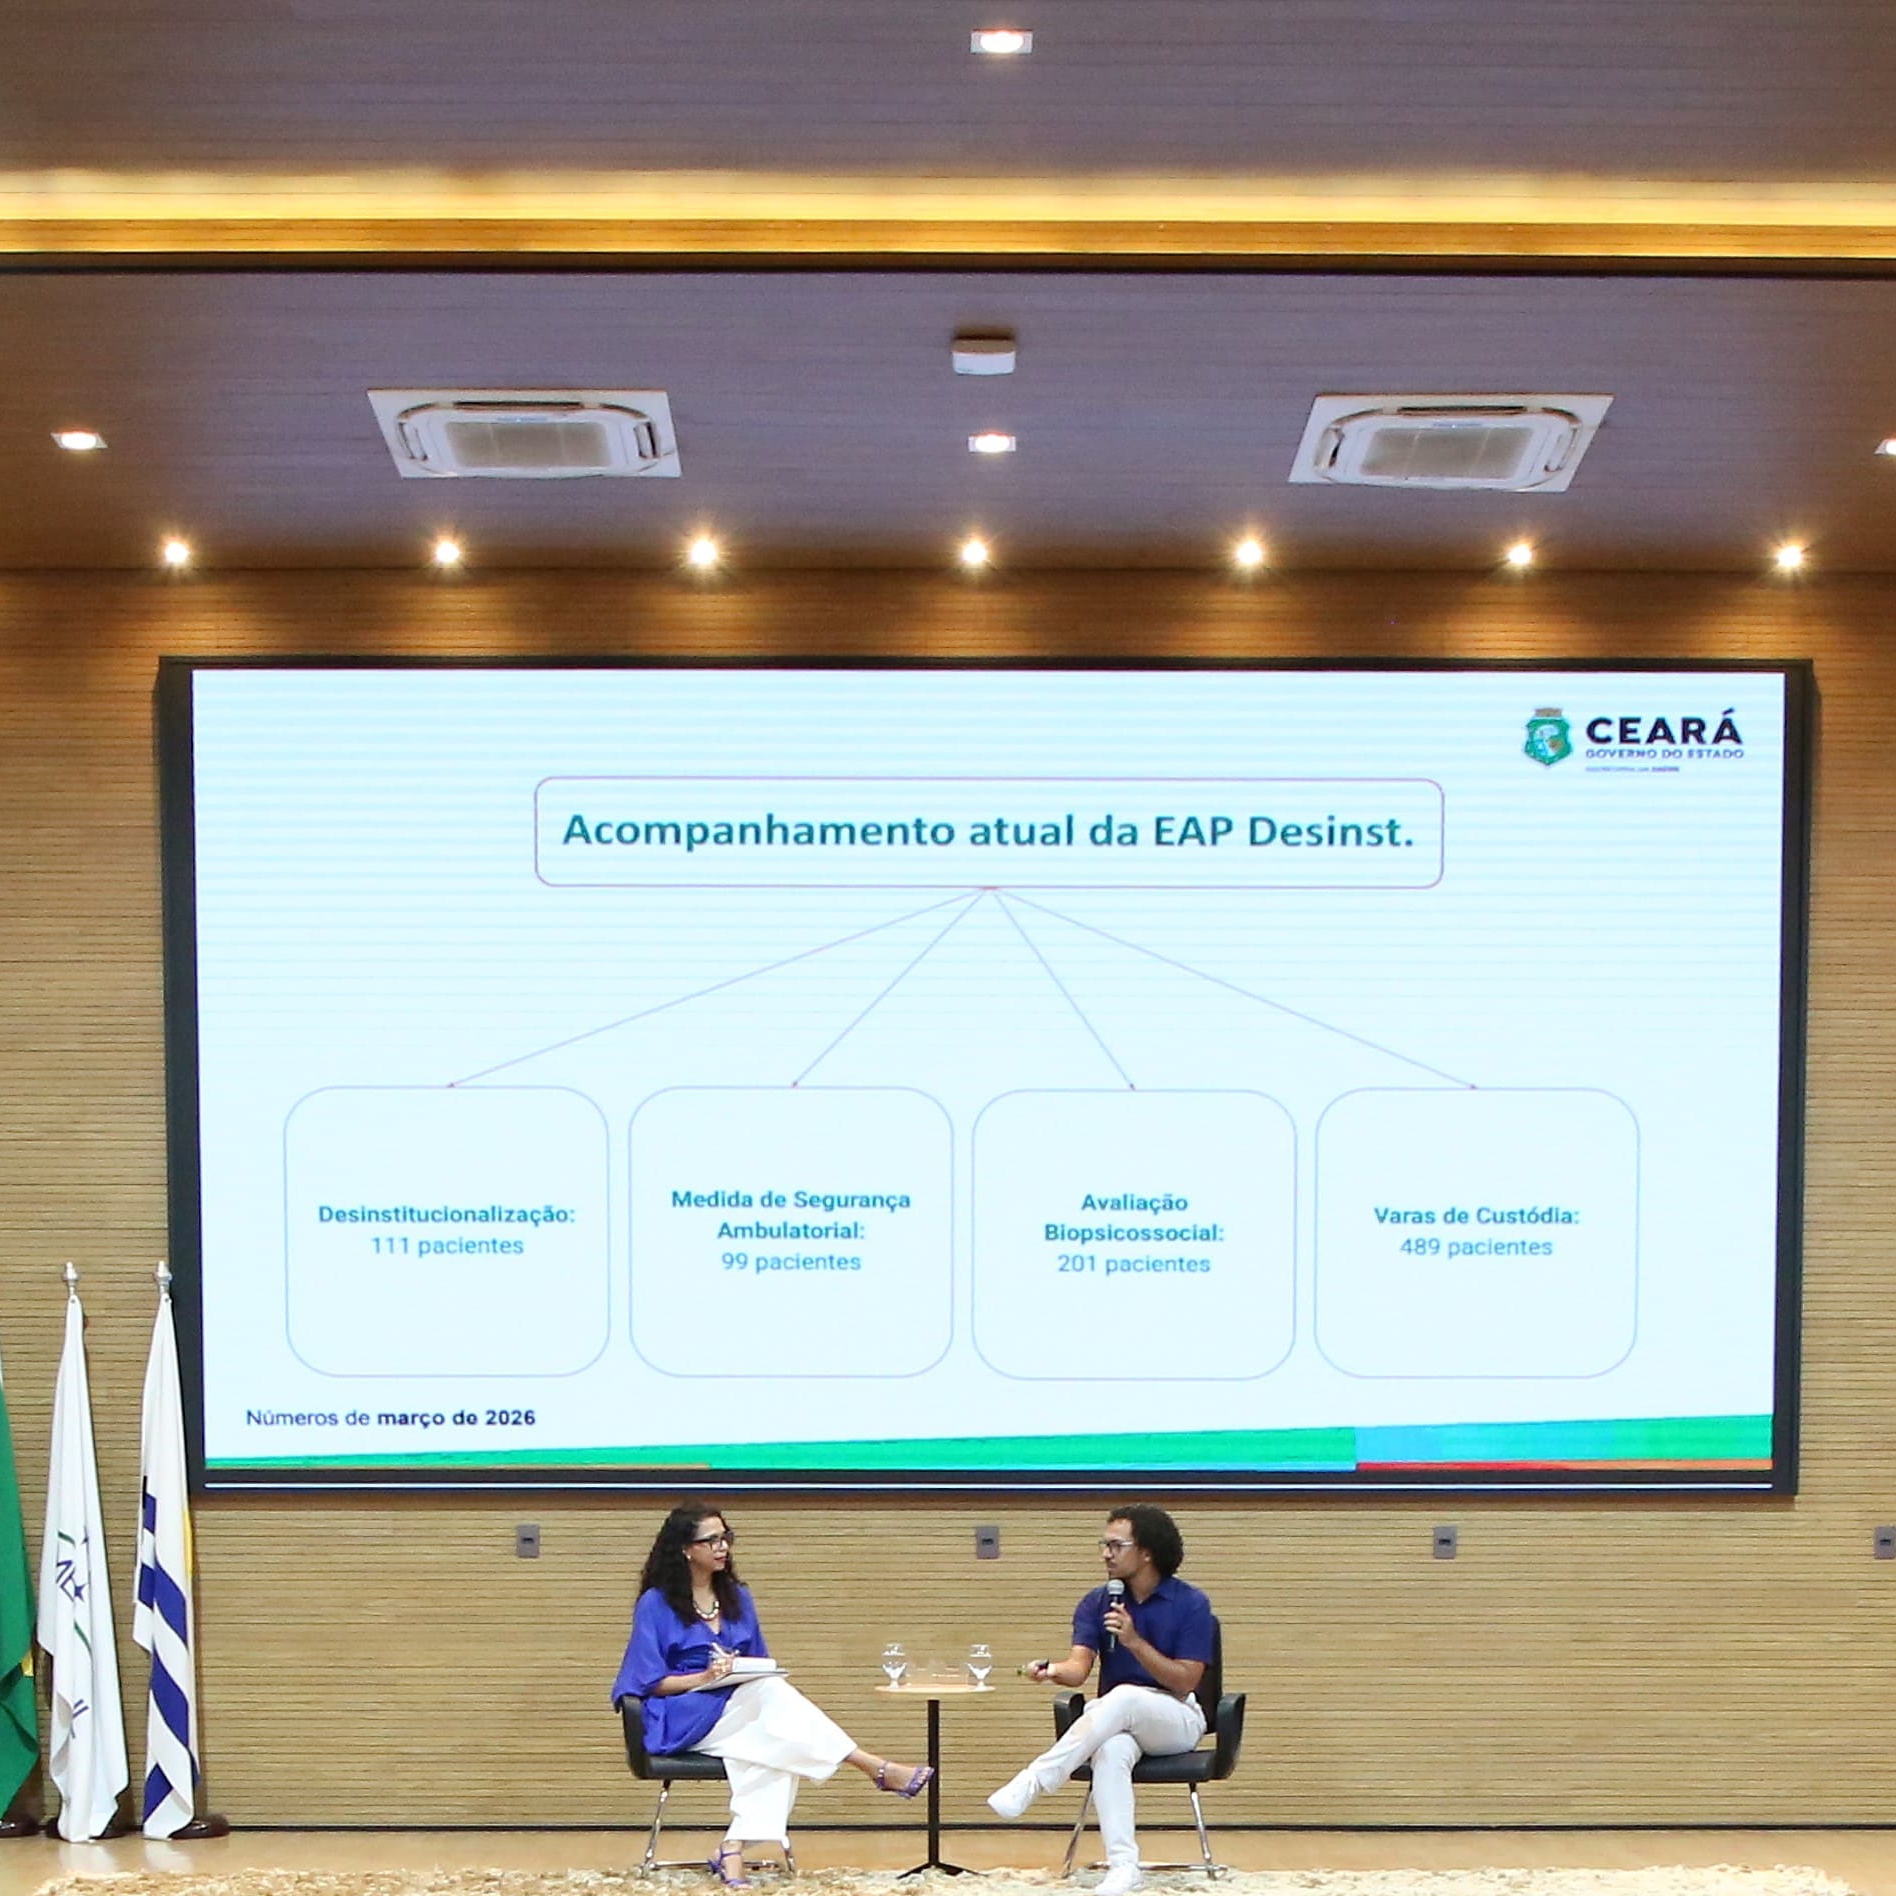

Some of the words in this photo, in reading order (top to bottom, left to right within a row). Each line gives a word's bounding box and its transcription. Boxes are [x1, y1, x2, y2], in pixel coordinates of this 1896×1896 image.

[1586, 706, 1743, 745] CEARÁ
[1585, 748, 1658, 759] GOVERNO
[1661, 748, 1684, 759] DO
[1686, 748, 1745, 759] ESTADO
[562, 812, 956, 853] Acompanhamento
[969, 812, 1074, 846] atual
[1088, 813, 1139, 847] da
[1154, 815, 1234, 847] EAP
[1249, 814, 1414, 847] Desinst.
[671, 1189, 754, 1208] Medida
[759, 1189, 788, 1208] de
[793, 1190, 912, 1214] Segurança
[1080, 1193, 1189, 1216] Avaliação
[318, 1204, 575, 1228] Desinstitucionalização:
[1373, 1206, 1437, 1225] Varas
[1442, 1206, 1470, 1225] de
[1476, 1205, 1580, 1225] Custódia:
[717, 1220, 865, 1240] Ambulatorial:
[1044, 1223, 1224, 1246] Biopsicossocial:
[371, 1236, 409, 1255] 111
[417, 1236, 525, 1259] pacientes
[1400, 1236, 1442, 1256] 489
[1447, 1237, 1554, 1260] pacientes
[721, 1251, 749, 1271] 99
[754, 1252, 862, 1275] pacientes
[1057, 1253, 1096, 1273] 201
[1104, 1254, 1212, 1277] pacientes
[246, 1409, 339, 1426] Números
[344, 1409, 370, 1426] de
[377, 1412, 446, 1430] março
[451, 1409, 479, 1426] de
[485, 1408, 536, 1426] 2026
